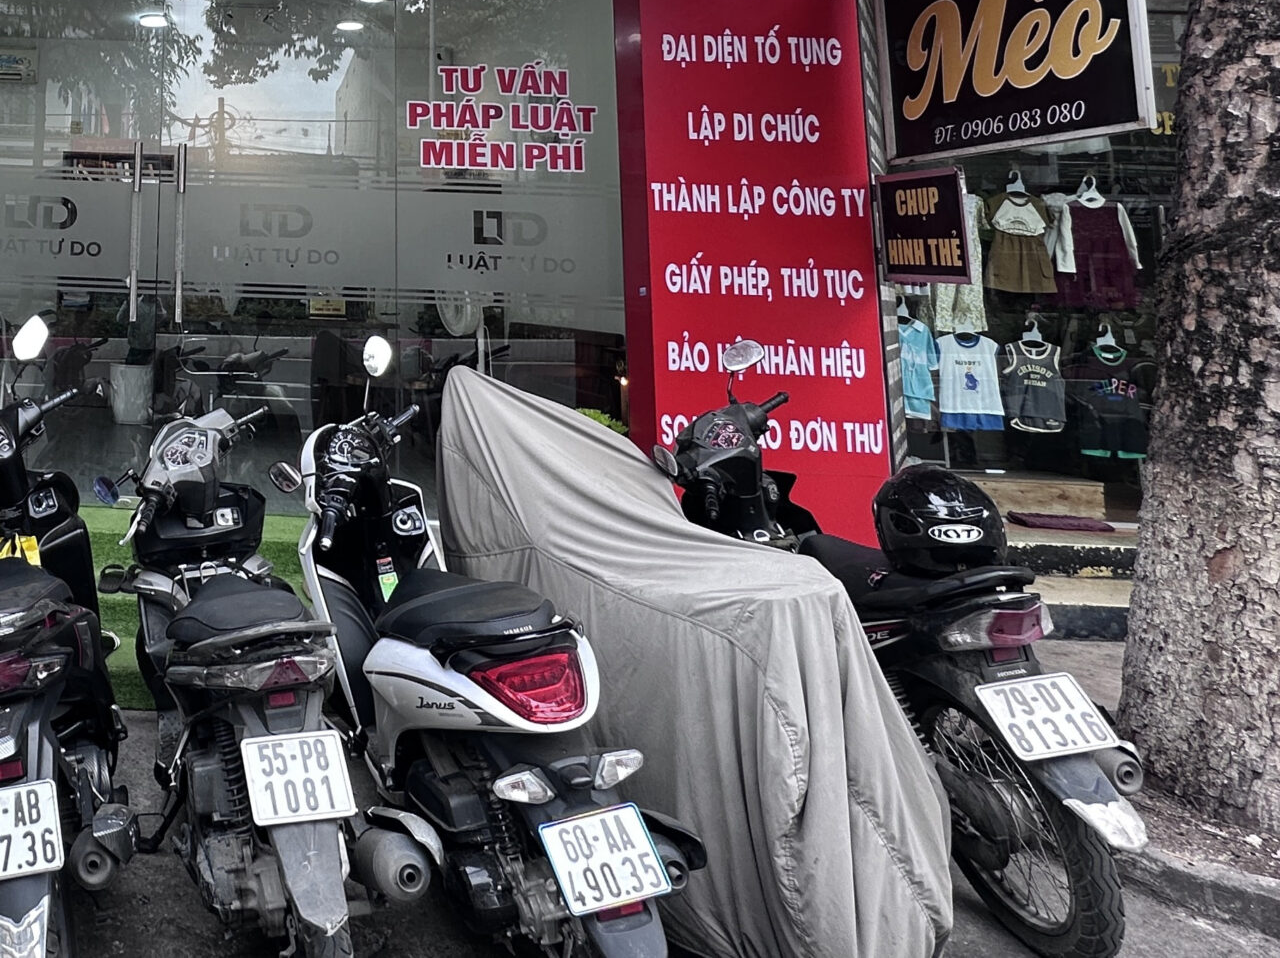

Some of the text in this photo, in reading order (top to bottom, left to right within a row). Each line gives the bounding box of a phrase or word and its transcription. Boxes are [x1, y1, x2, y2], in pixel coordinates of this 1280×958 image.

[661, 24, 842, 72] ĐẠI DIỆN TỐ TỤNG
[439, 59, 568, 97] TƯ VẤN
[407, 97, 597, 139] PHÁP LUẬT
[687, 105, 820, 146] LẬP DI CHÚC
[960, 118, 1004, 141] 0906
[1008, 109, 1041, 132] 083
[1047, 100, 1086, 123] 080
[420, 132, 586, 173] MIỄN PHÍ
[651, 177, 865, 220] THÀNH LẬP CÔNG TY
[895, 187, 939, 221] CHỤP
[70, 241, 102, 257] DO
[307, 249, 340, 265] DO
[888, 230, 962, 266] HÌNH THẺ
[665, 252, 864, 306] GIẤY PHÉP, THỦ TỤC
[667, 330, 710, 372] BẢO
[756, 338, 815, 376] NHÃN
[820, 340, 866, 385] HIỆU
[789, 417, 838, 452] ĐƠN
[843, 419, 883, 454] THƯ
[415, 696, 456, 710] Janus
[993, 681, 1075, 719] 79-D1
[1007, 711, 1108, 753] 813.16
[258, 738, 330, 778] 55-P8
[265, 774, 336, 817] 1081
[557, 815, 636, 863] 60-AA
[569, 850, 663, 907] 490.35
